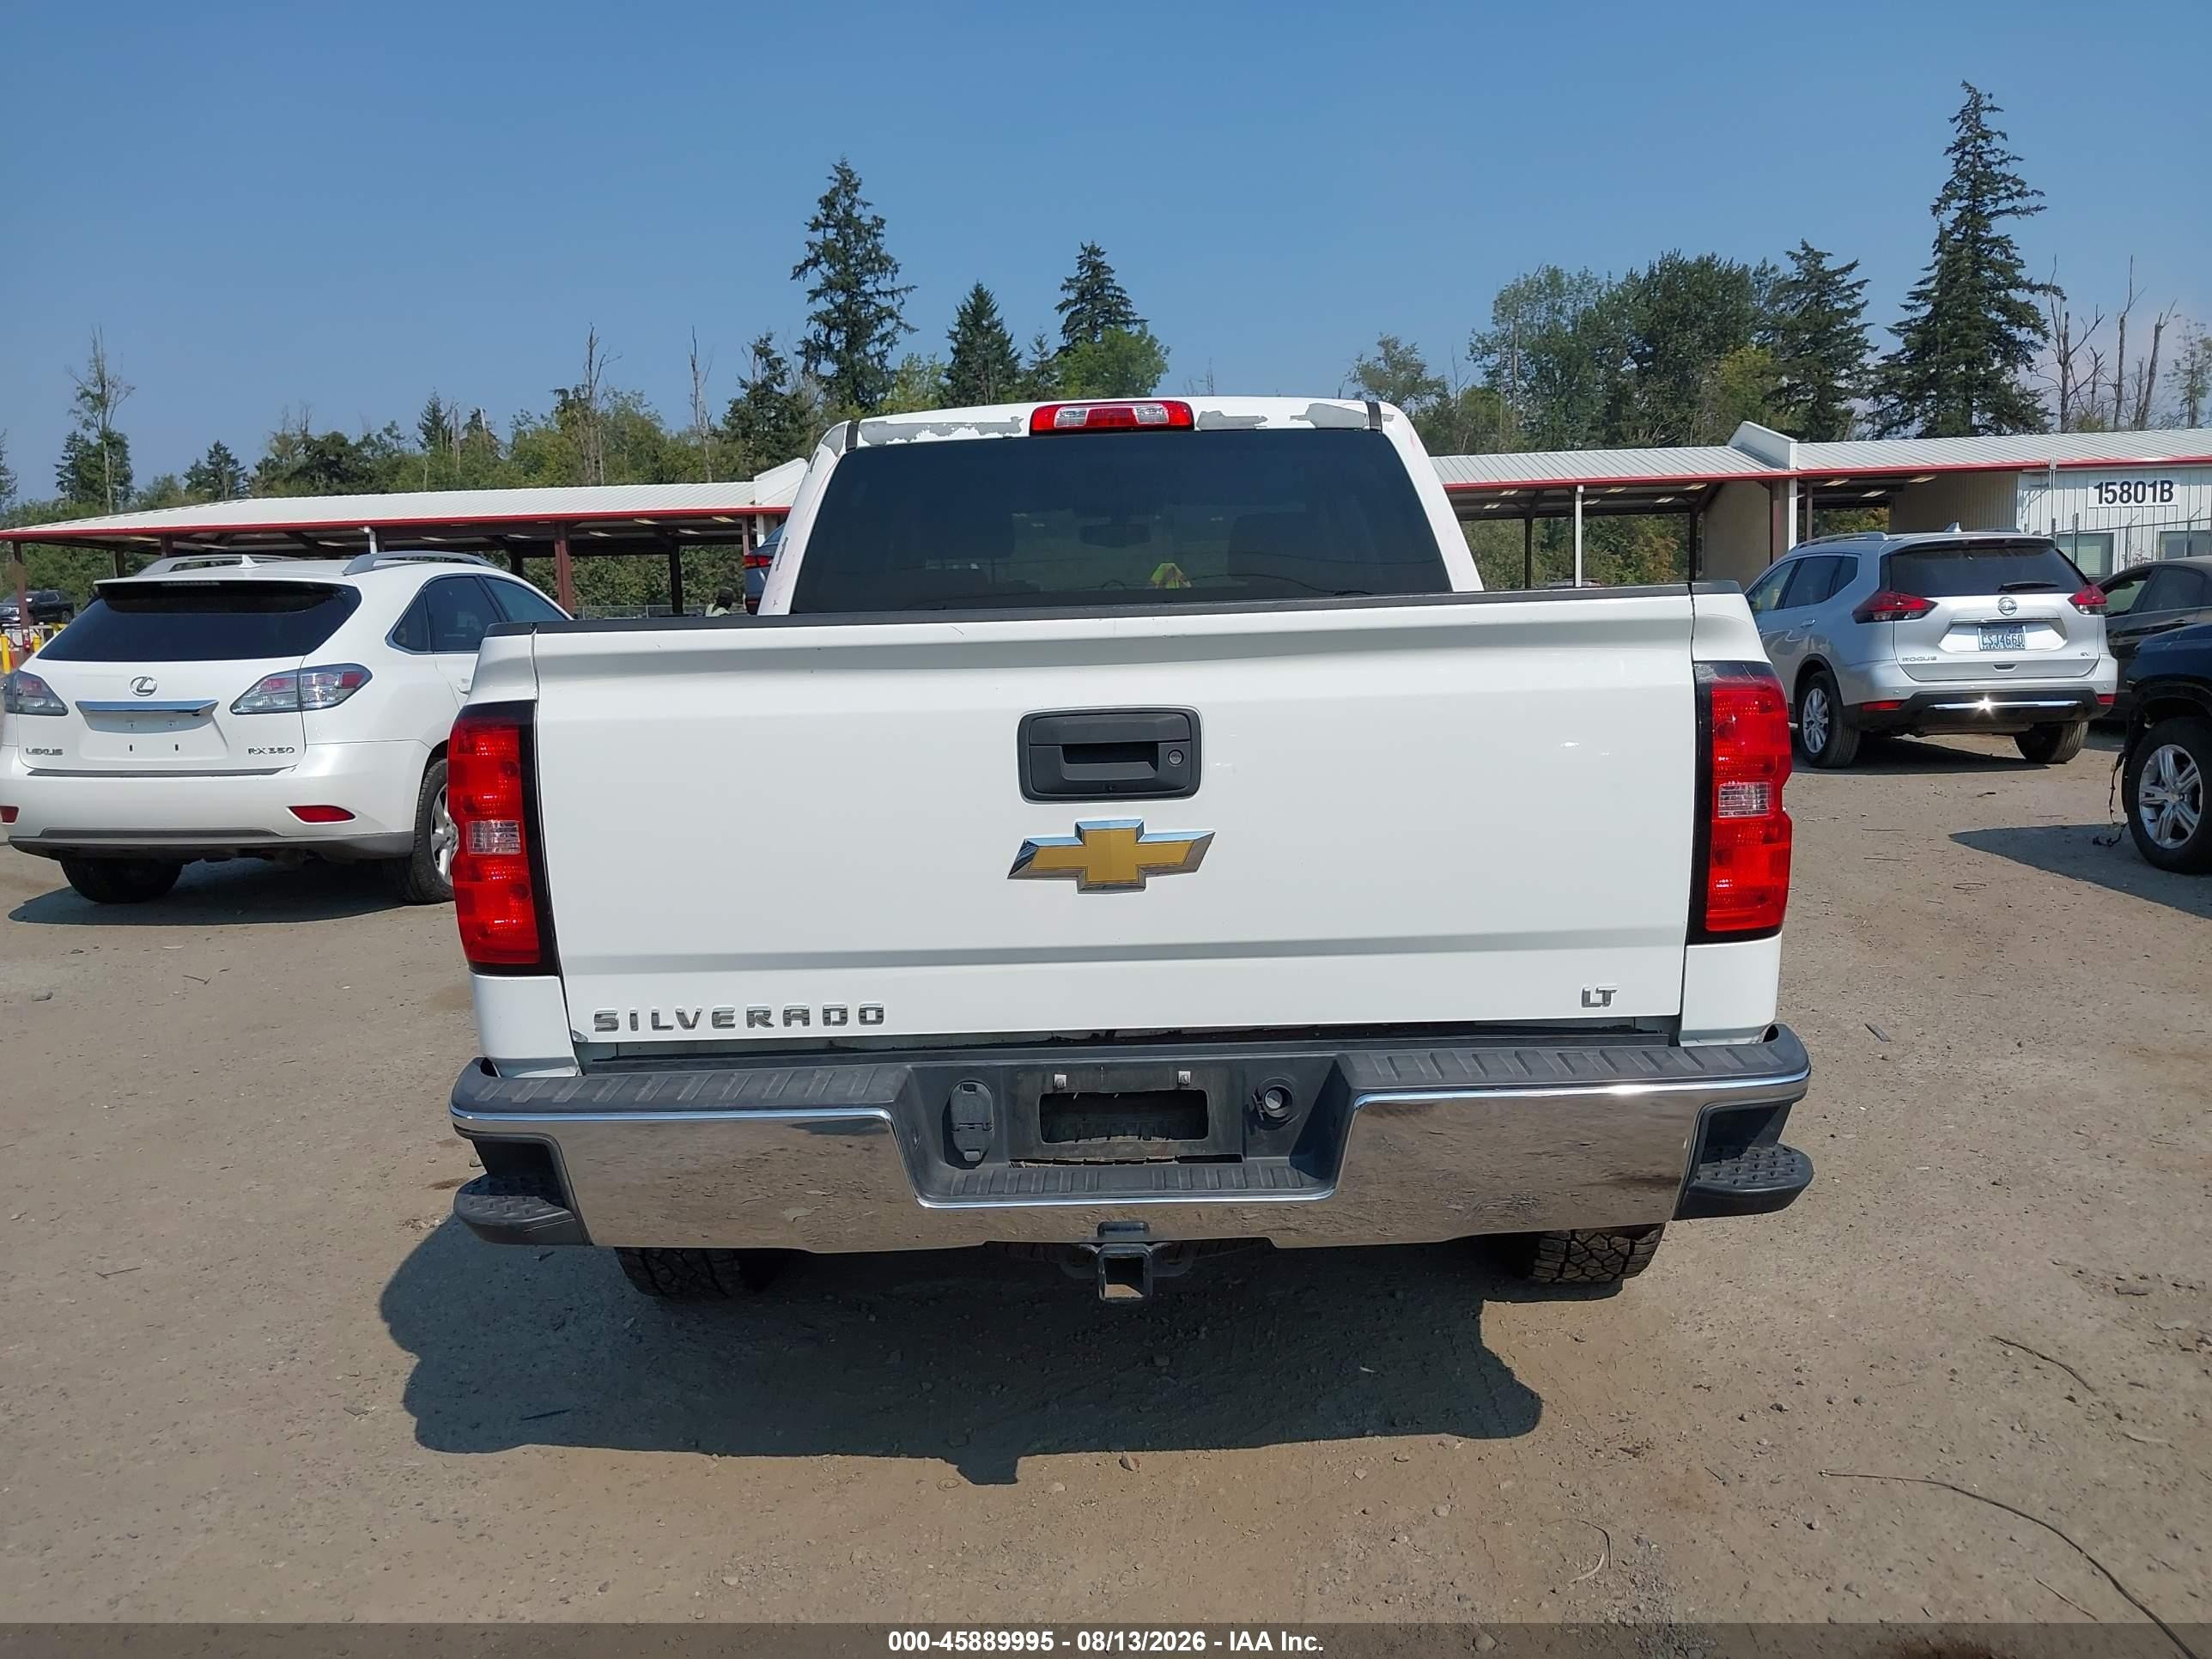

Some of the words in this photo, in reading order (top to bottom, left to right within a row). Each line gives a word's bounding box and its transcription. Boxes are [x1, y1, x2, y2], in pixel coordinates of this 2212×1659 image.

[2094, 479, 2173, 504] 15801B
[26, 747, 64, 756] LEXUS
[1582, 987, 1618, 1007] LT
[594, 1003, 884, 1032] SILVERADO
